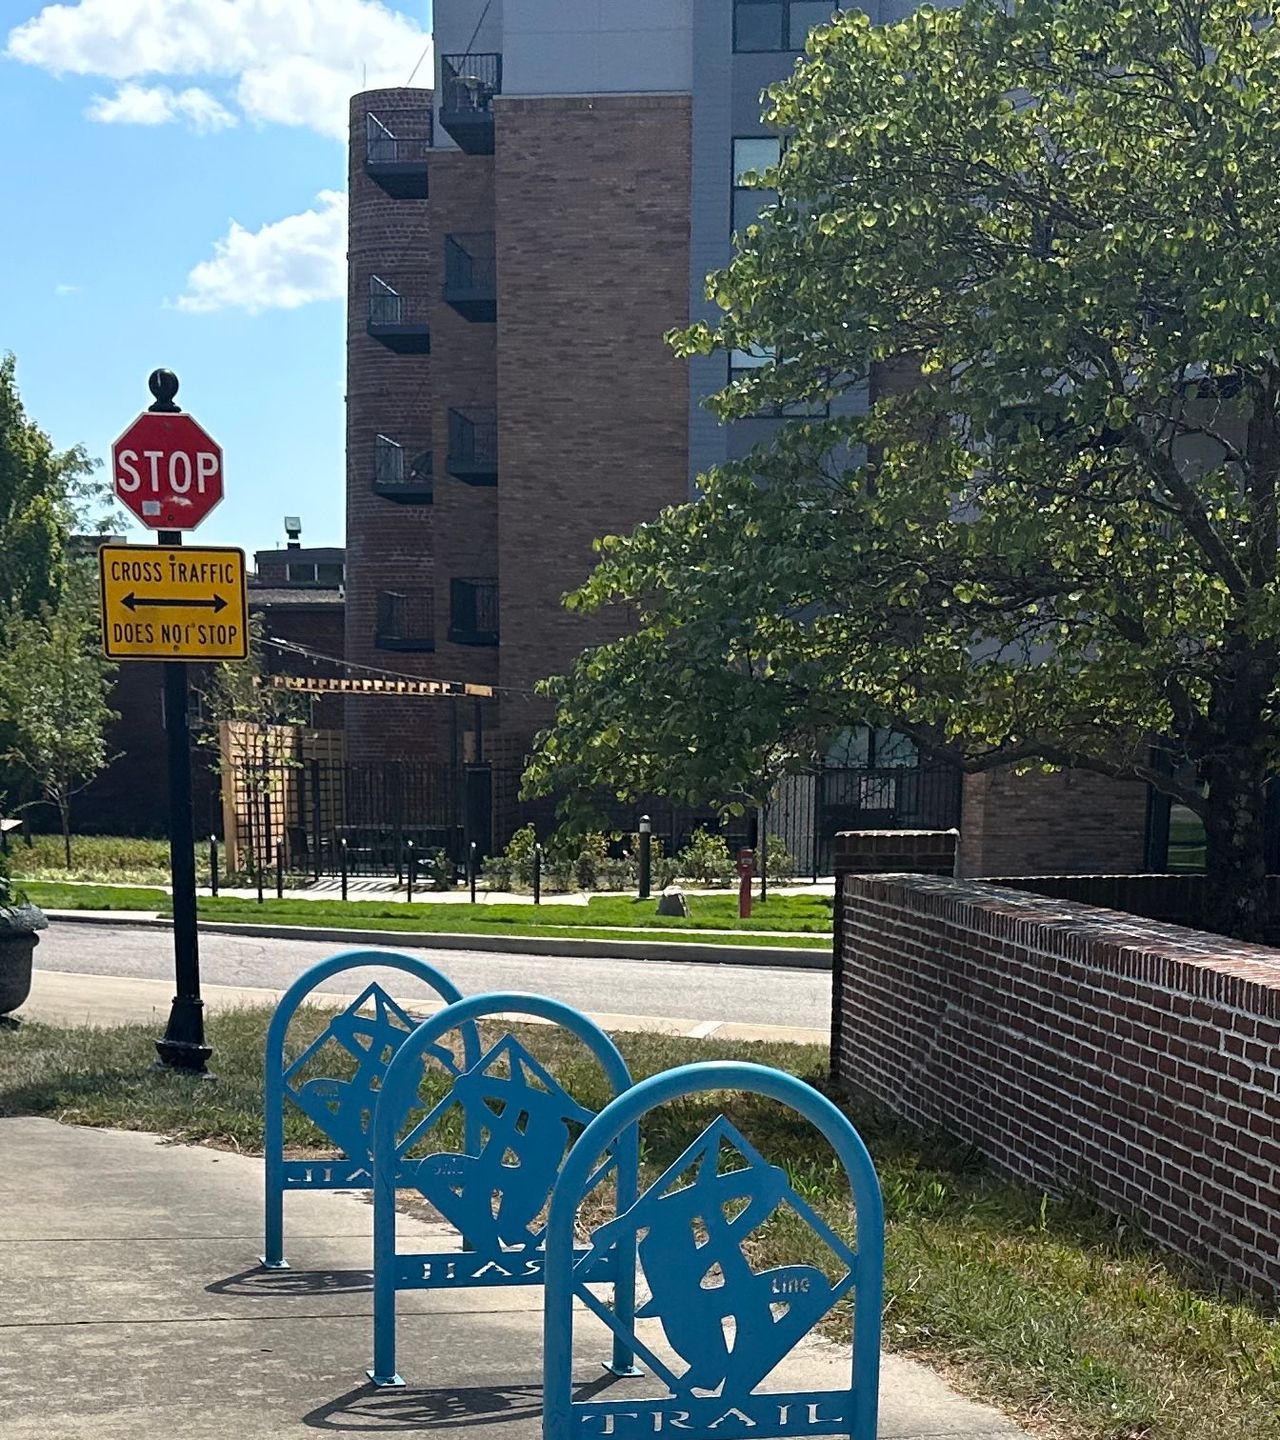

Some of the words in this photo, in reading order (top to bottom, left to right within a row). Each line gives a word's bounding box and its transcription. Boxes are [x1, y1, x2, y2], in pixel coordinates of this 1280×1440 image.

[118, 450, 219, 493] STOP
[111, 561, 163, 583] CROSS
[170, 561, 235, 585] TRAFFIC
[113, 623, 154, 644] DOES
[161, 623, 194, 646] NOT
[197, 624, 238, 646] STOP
[581, 1404, 843, 1435] TRAIL
